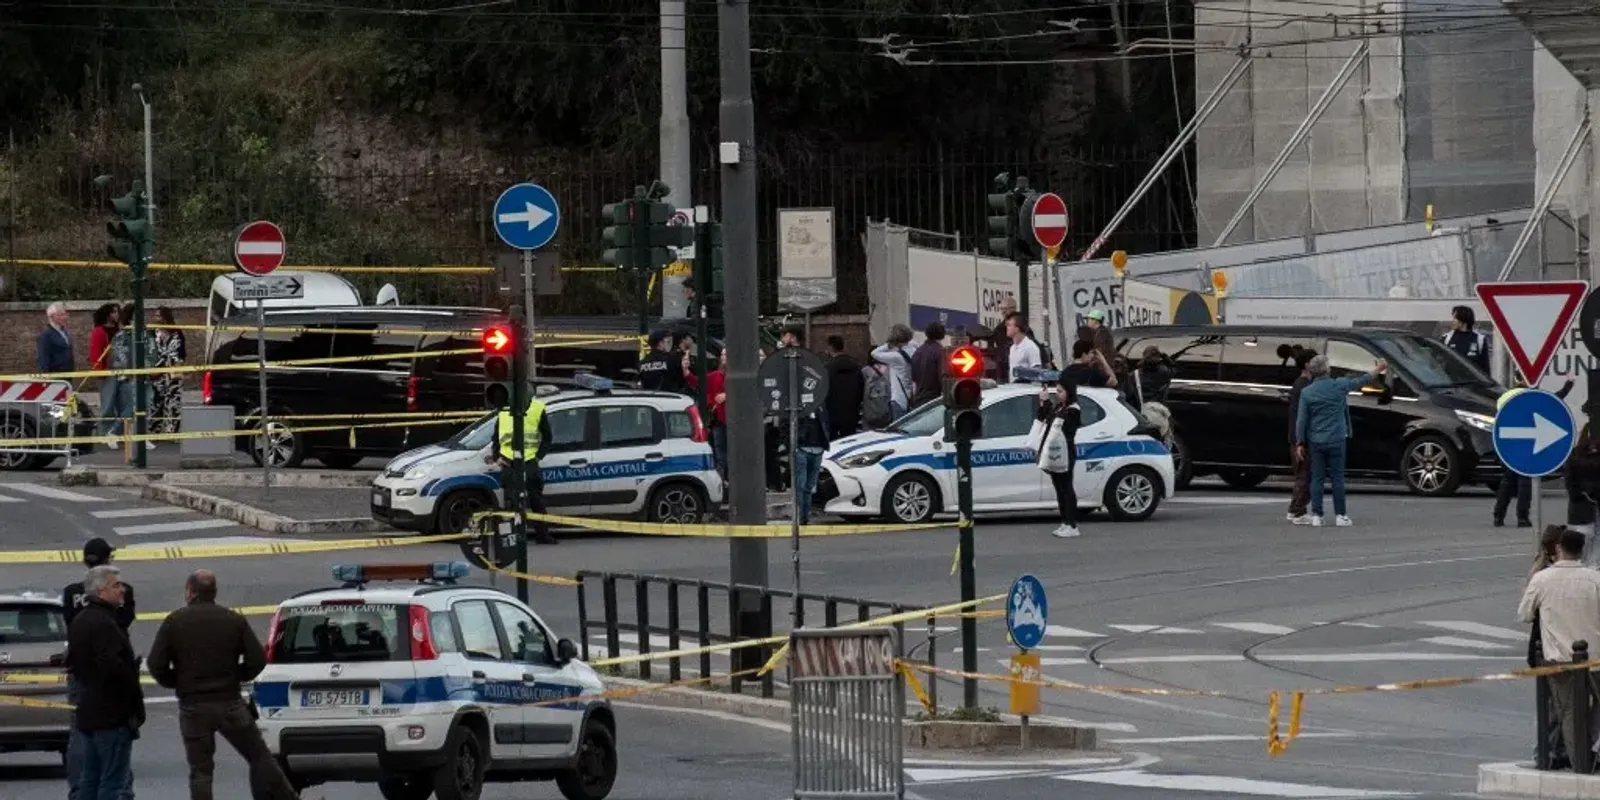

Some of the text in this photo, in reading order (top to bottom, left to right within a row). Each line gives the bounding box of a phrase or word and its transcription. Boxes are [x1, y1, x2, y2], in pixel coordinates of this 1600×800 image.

[640, 361, 668, 371] POLIZIA
[1009, 451, 1034, 461] ROM
[543, 463, 647, 480] IZIA ROMA CAPITALE
[290, 606, 326, 615] POLIZIA
